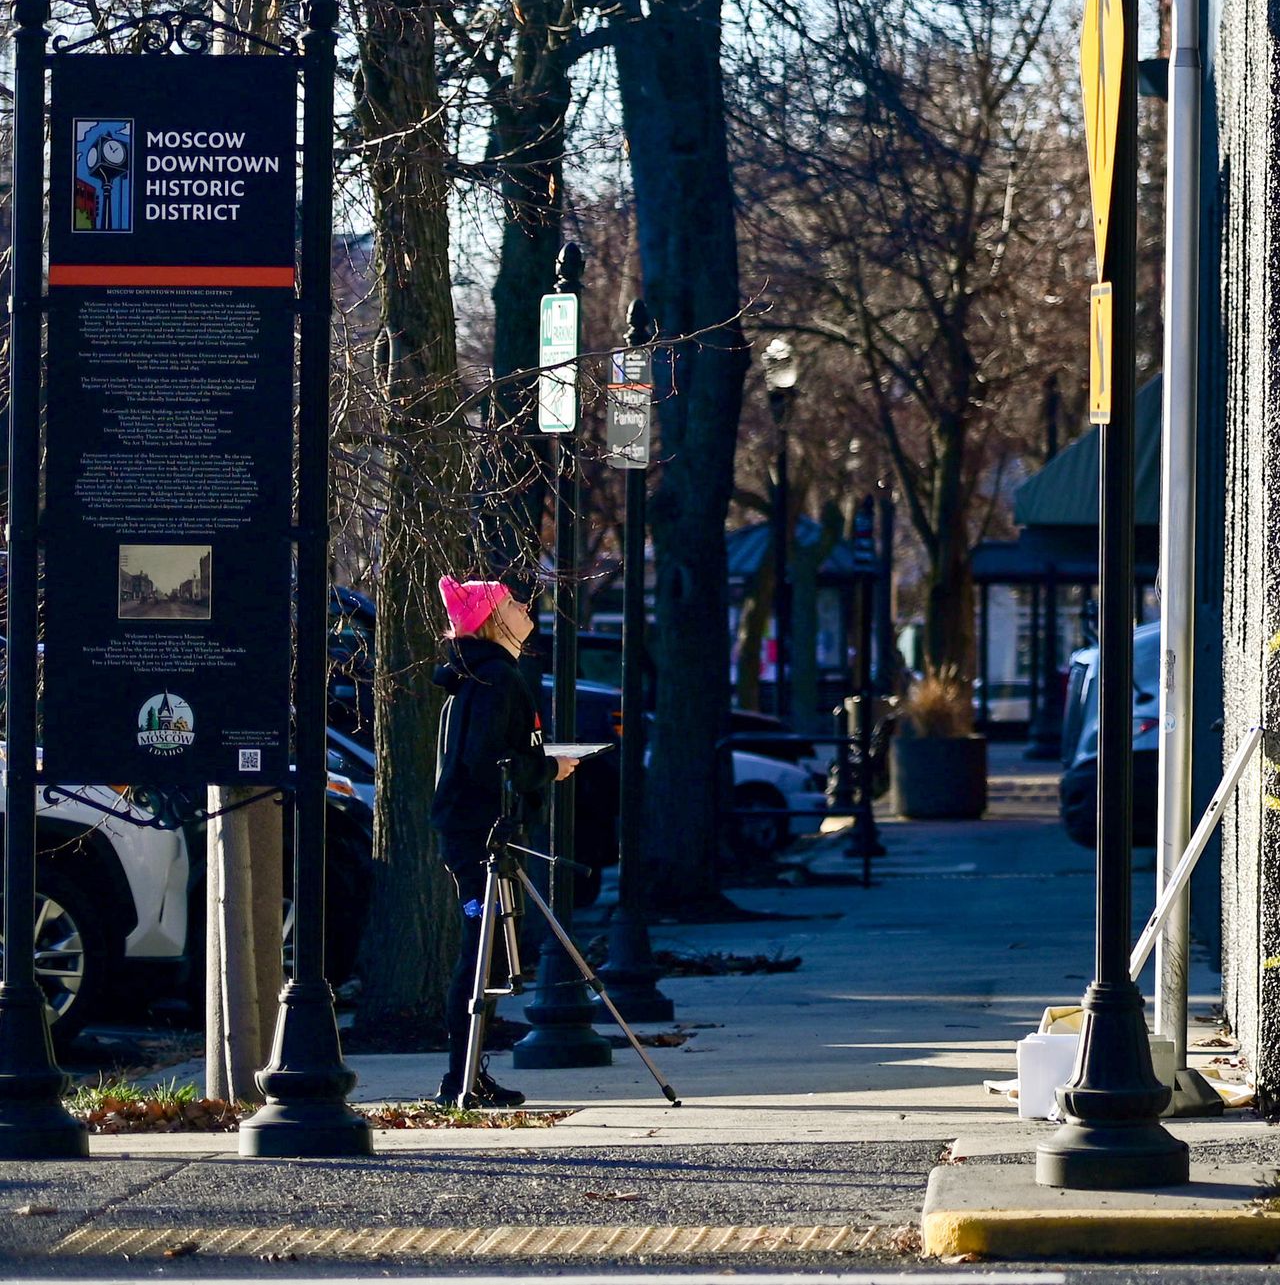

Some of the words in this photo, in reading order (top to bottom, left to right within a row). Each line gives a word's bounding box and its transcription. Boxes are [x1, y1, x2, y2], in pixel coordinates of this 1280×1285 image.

[146, 131, 246, 149] MOSCOW
[146, 155, 280, 173] DOWNTOWN
[145, 179, 245, 197] HISTORIC
[145, 203, 241, 221] DISTRICT
[140, 734, 192, 744] MOSCOW
[148, 747, 184, 757] IDAHO
